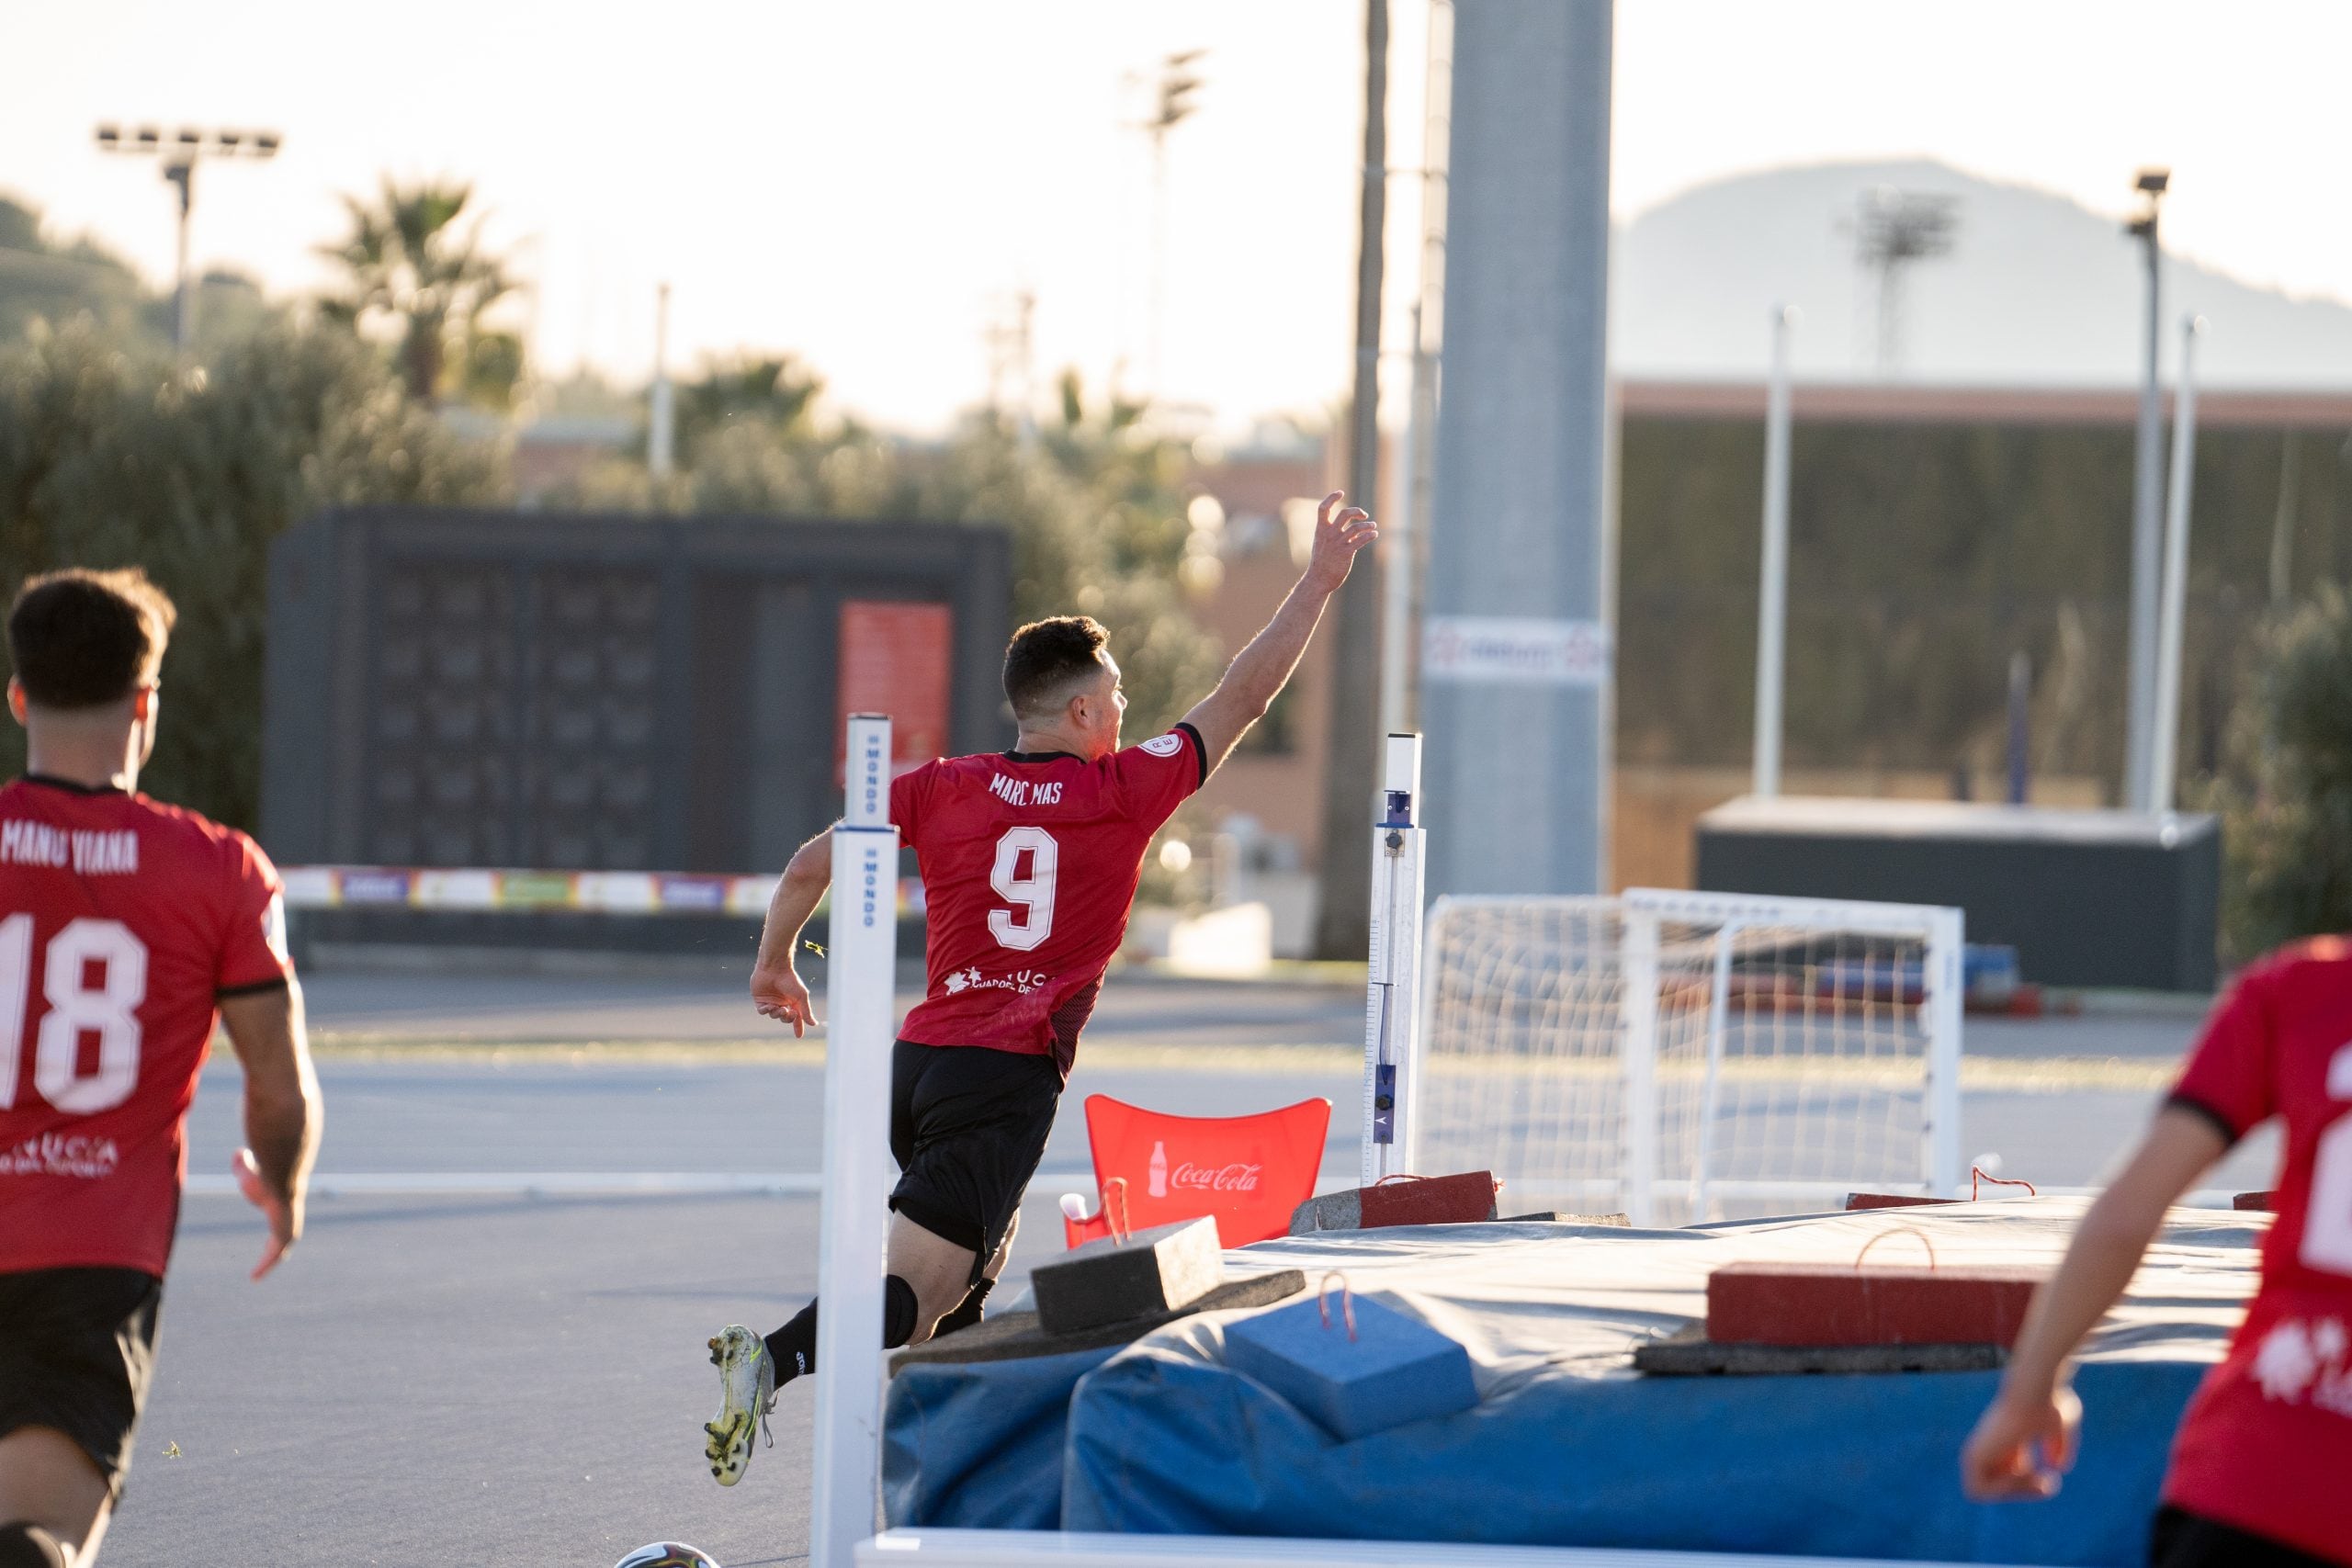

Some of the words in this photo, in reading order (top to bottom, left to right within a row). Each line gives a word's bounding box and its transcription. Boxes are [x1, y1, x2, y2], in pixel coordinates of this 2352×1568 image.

[865, 749, 881, 815] MONDO
[989, 773, 1029, 807] MARC
[1030, 782, 1063, 806] MAS
[0, 818, 68, 868] MANU
[72, 829, 139, 876] VIANA
[863, 862, 878, 928] MONDO
[988, 826, 1058, 951] 9
[0, 912, 148, 1115] 18
[1170, 1162, 1263, 1191] Coca-Cola
